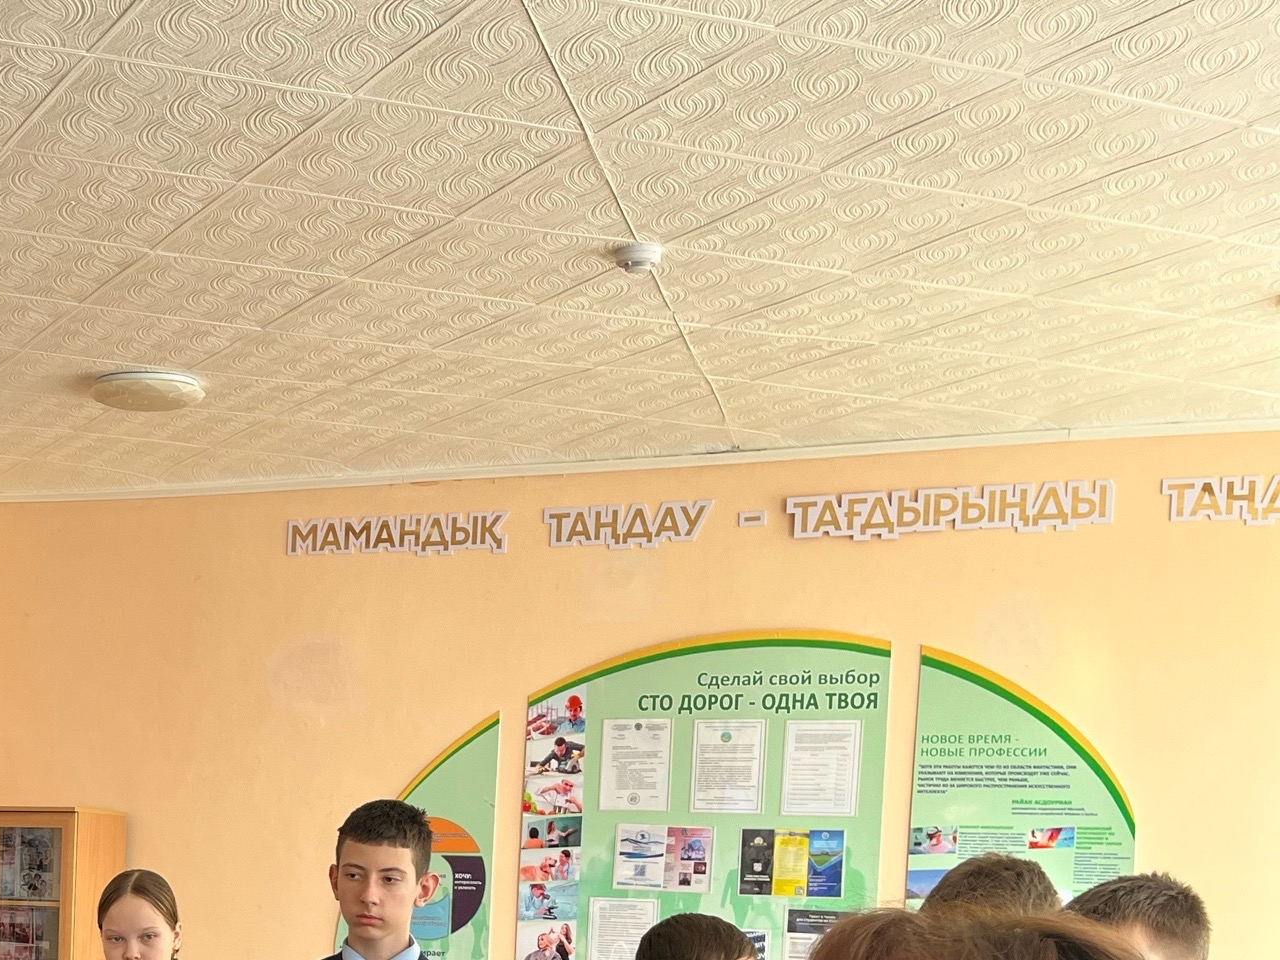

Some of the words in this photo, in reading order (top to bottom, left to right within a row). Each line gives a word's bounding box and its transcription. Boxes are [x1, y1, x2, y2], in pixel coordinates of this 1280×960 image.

[548, 504, 707, 545] ТАҢДАУ
[697, 671, 763, 690] Сделай
[769, 670, 812, 686] свой
[818, 669, 881, 687] выбор
[638, 694, 673, 712] СТО
[678, 693, 744, 714] ДОРОГ
[761, 693, 819, 714] ОДНА
[825, 692, 879, 710] ТВОЯ
[921, 734, 964, 744] НОВОЕ
[967, 734, 1012, 744] ВРЕМЯ
[920, 747, 965, 757] НОВЫЕ
[969, 747, 1048, 757] ПРОФЕССИИ
